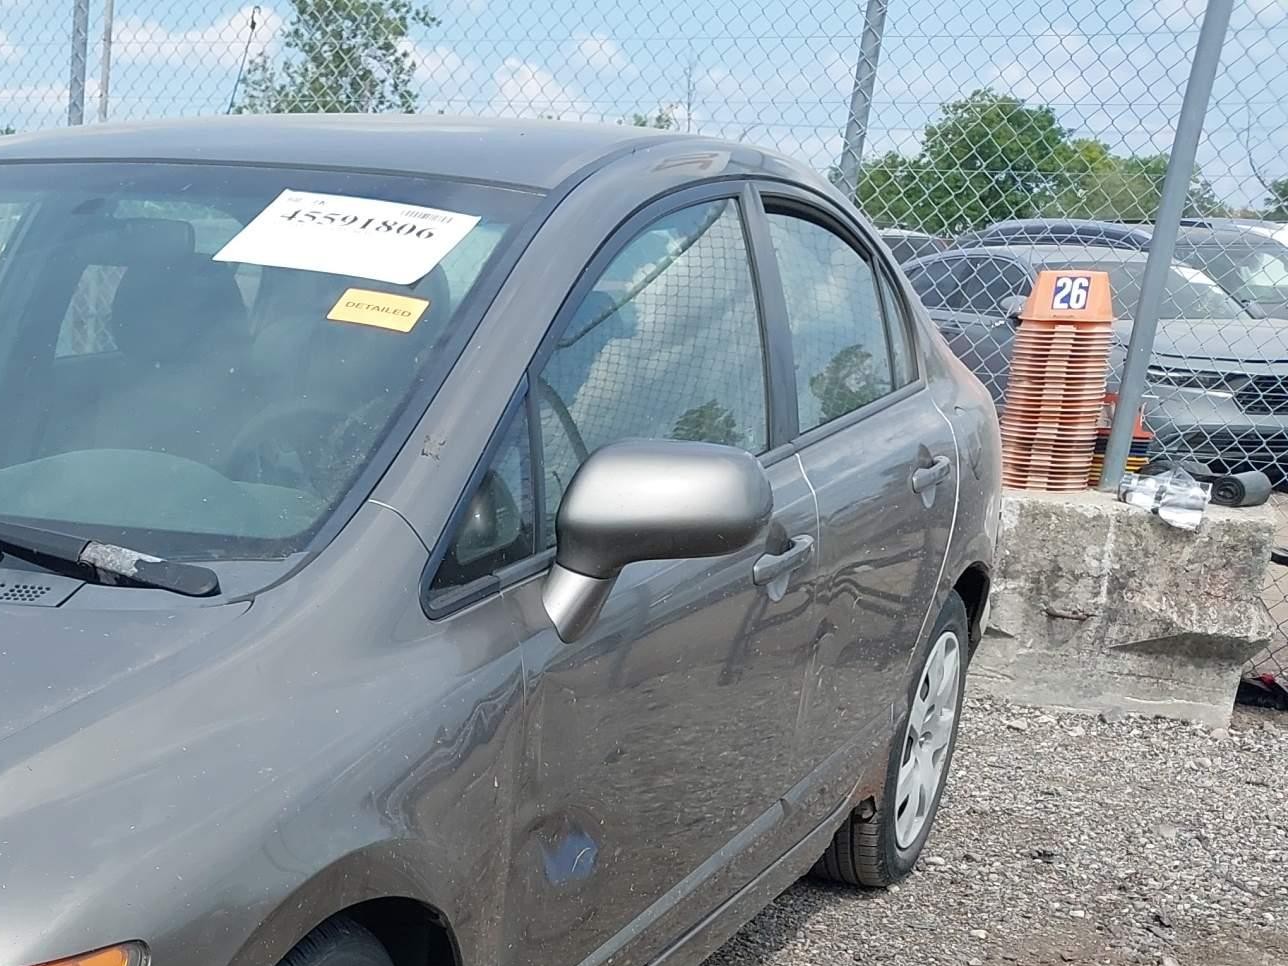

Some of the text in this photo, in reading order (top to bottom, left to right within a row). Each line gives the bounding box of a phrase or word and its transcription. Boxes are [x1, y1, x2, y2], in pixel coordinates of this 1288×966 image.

[279, 208, 435, 240] 45591806
[344, 300, 412, 318] DETAILED
[1050, 277, 1089, 310] 26
